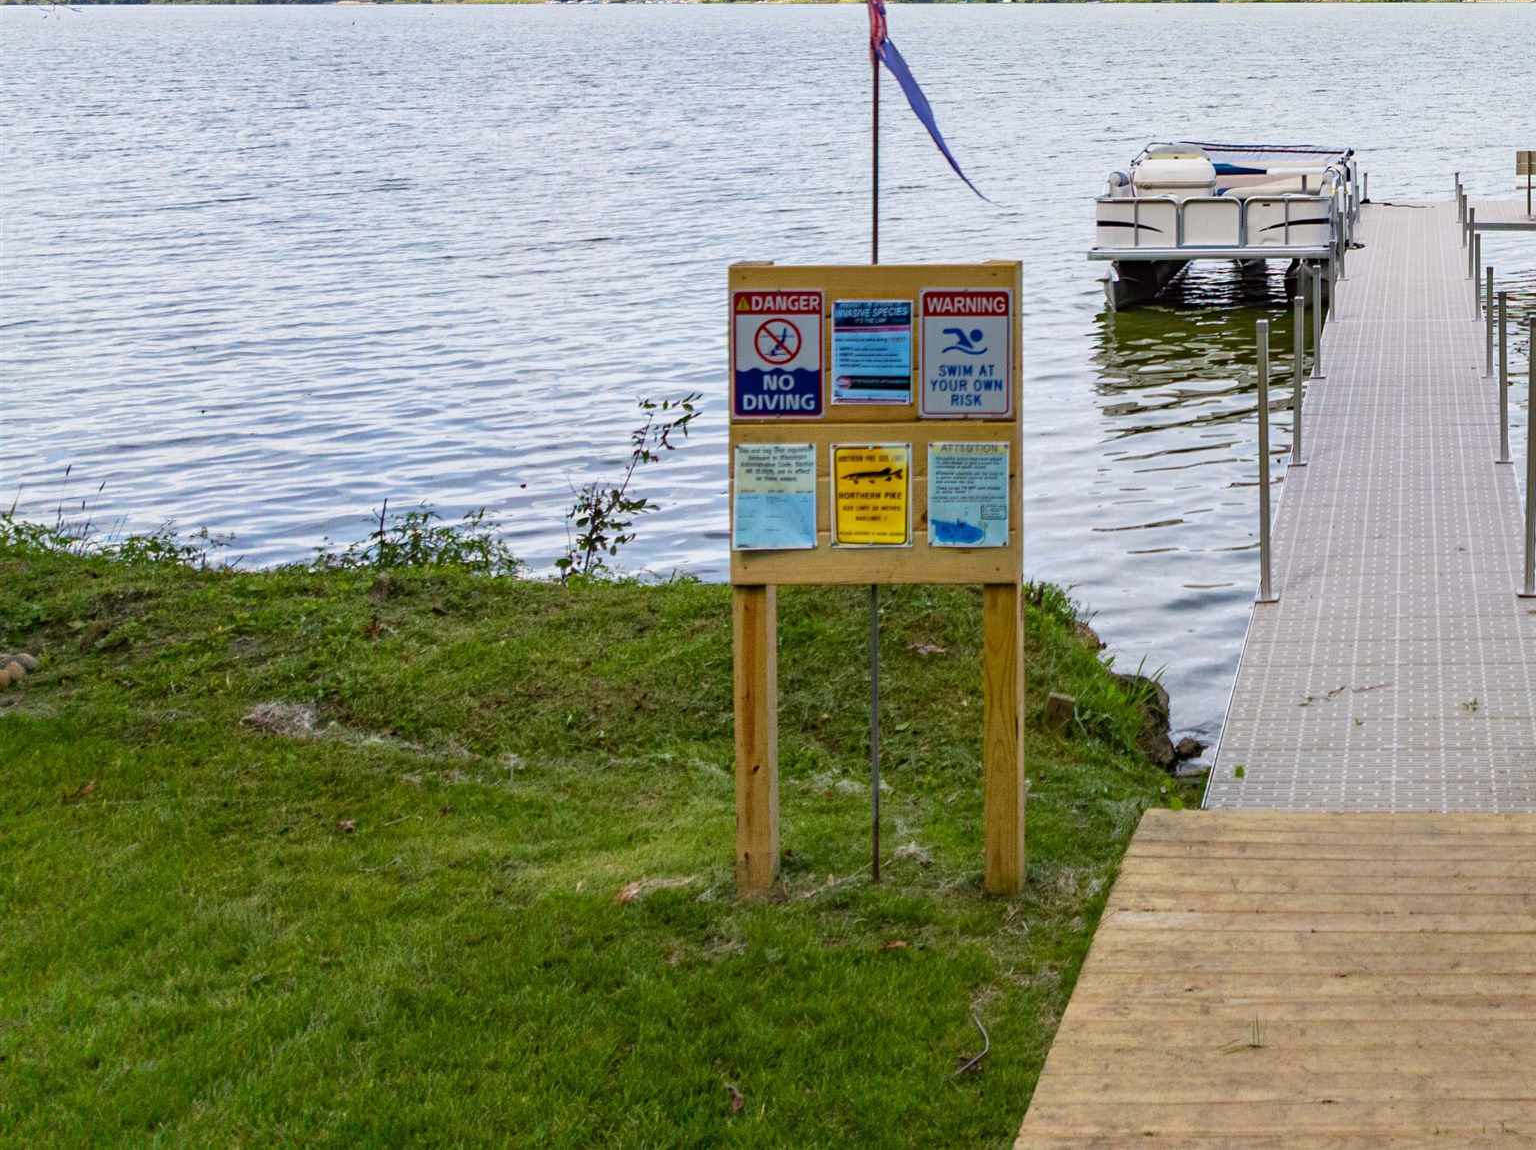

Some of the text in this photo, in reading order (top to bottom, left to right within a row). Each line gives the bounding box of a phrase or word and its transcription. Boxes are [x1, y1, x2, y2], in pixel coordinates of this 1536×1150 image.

[751, 296, 820, 311] DANGER
[927, 297, 1006, 313] WARNING
[938, 365, 995, 377] SWIM AT
[763, 374, 795, 391] NO
[930, 379, 1003, 392] YOUR OWN
[743, 394, 816, 411] DIVING
[950, 394, 982, 406] RISK
